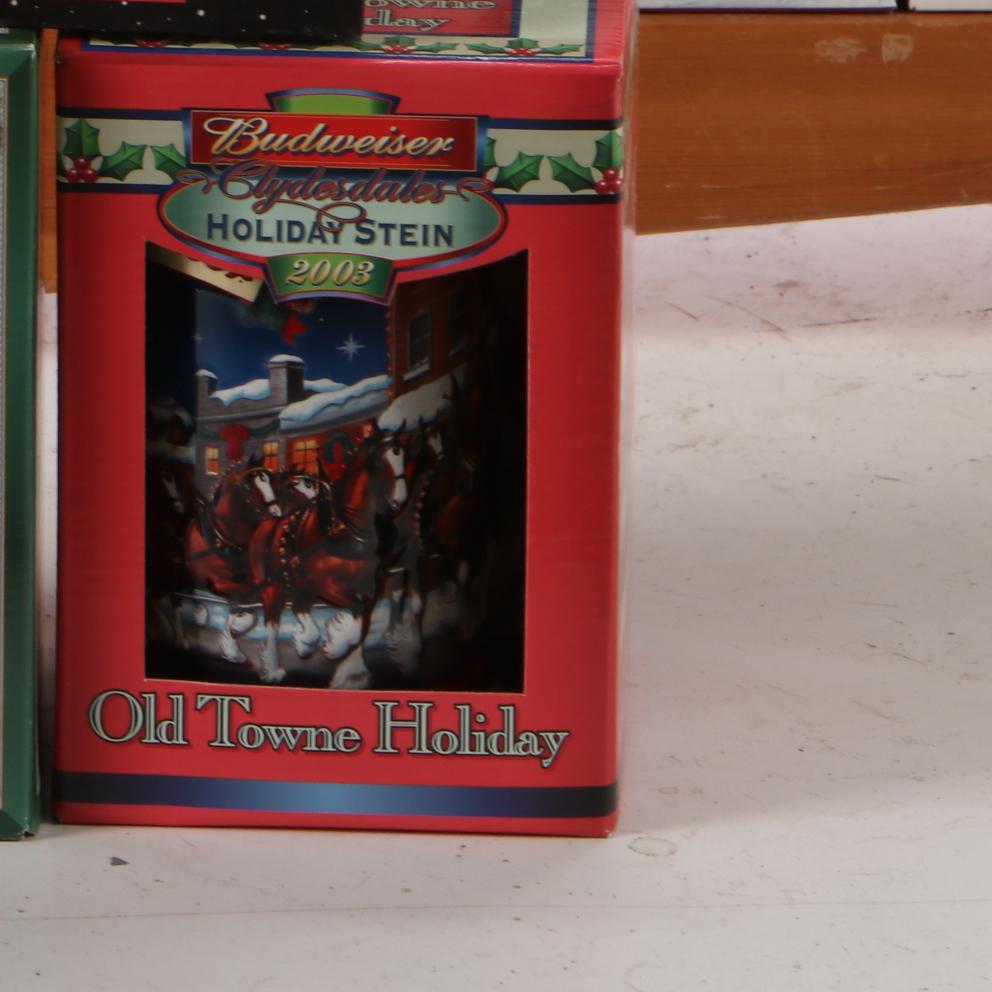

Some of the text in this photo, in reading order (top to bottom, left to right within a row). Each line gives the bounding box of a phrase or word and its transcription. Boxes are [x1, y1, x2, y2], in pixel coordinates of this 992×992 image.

[203, 116, 455, 157] Budweiser
[178, 158, 494, 215] Clydesdales
[208, 213, 455, 248] HOLIDAY STEIN
[284, 259, 375, 288] 2003
[88, 690, 571, 768] Old Towne Holiday
